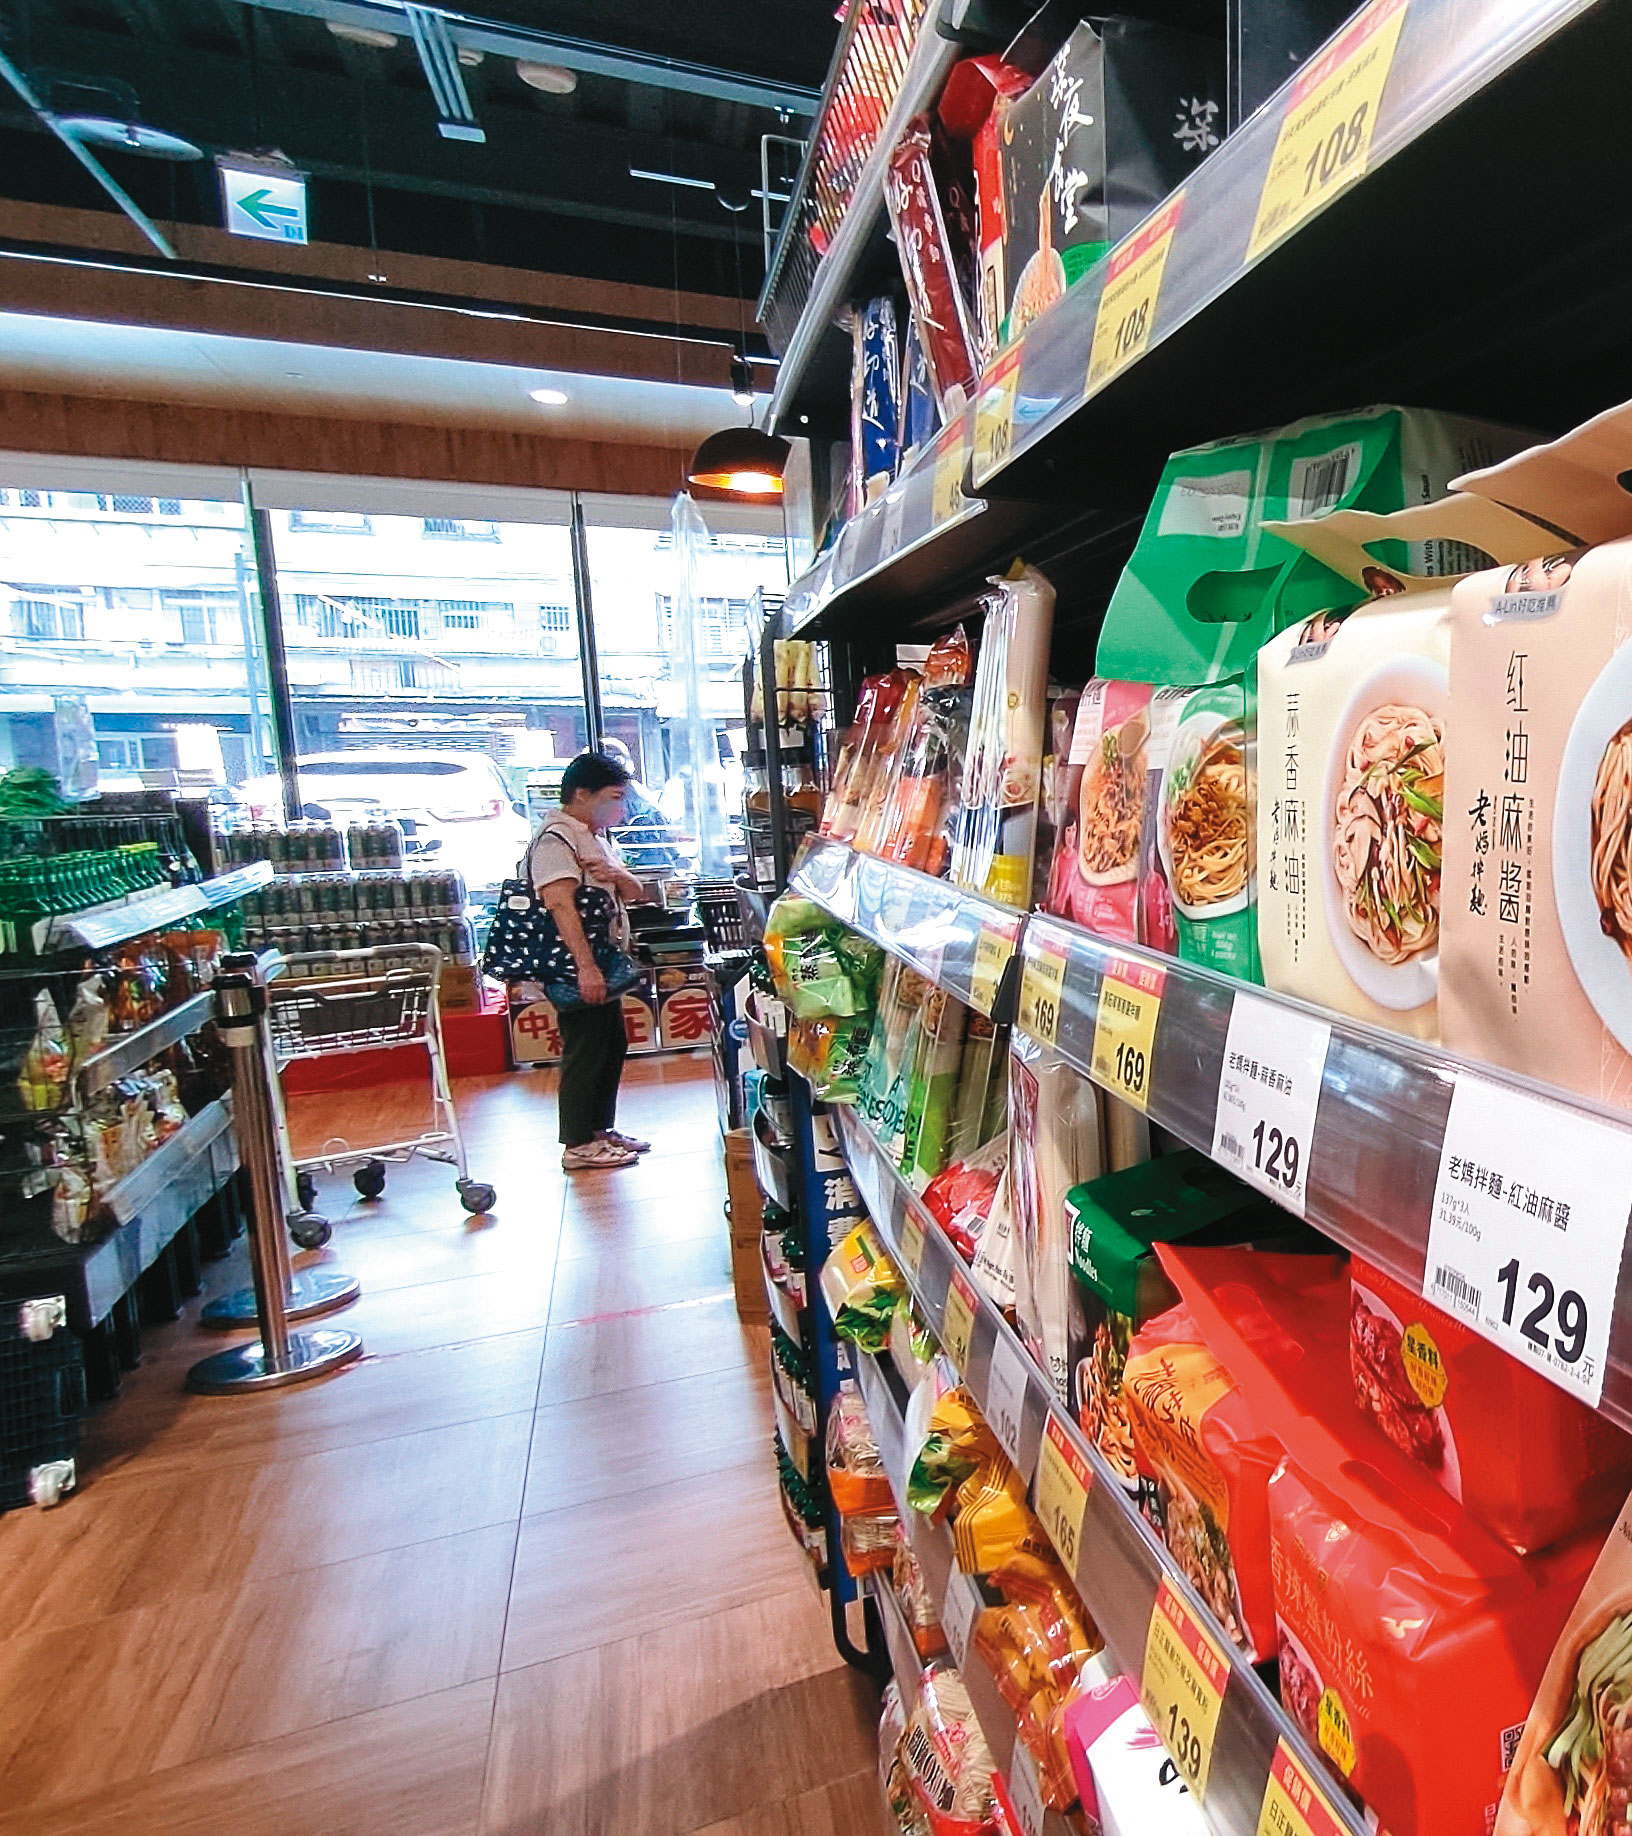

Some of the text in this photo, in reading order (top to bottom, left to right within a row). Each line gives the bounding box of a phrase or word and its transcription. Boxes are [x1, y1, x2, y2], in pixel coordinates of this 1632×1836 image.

[1304, 101, 1368, 198] 108
[1115, 298, 1149, 359] 108
[1034, 997, 1054, 1037] 169
[1116, 1042, 1145, 1092] 169
[1253, 1120, 1299, 1188] 129
[1448, 1155, 1571, 1232] 老媽拌麵-紅油麻醬
[1498, 1258, 1588, 1364] 129
[1054, 1505, 1075, 1559] 165
[1167, 1703, 1201, 1781] 139
